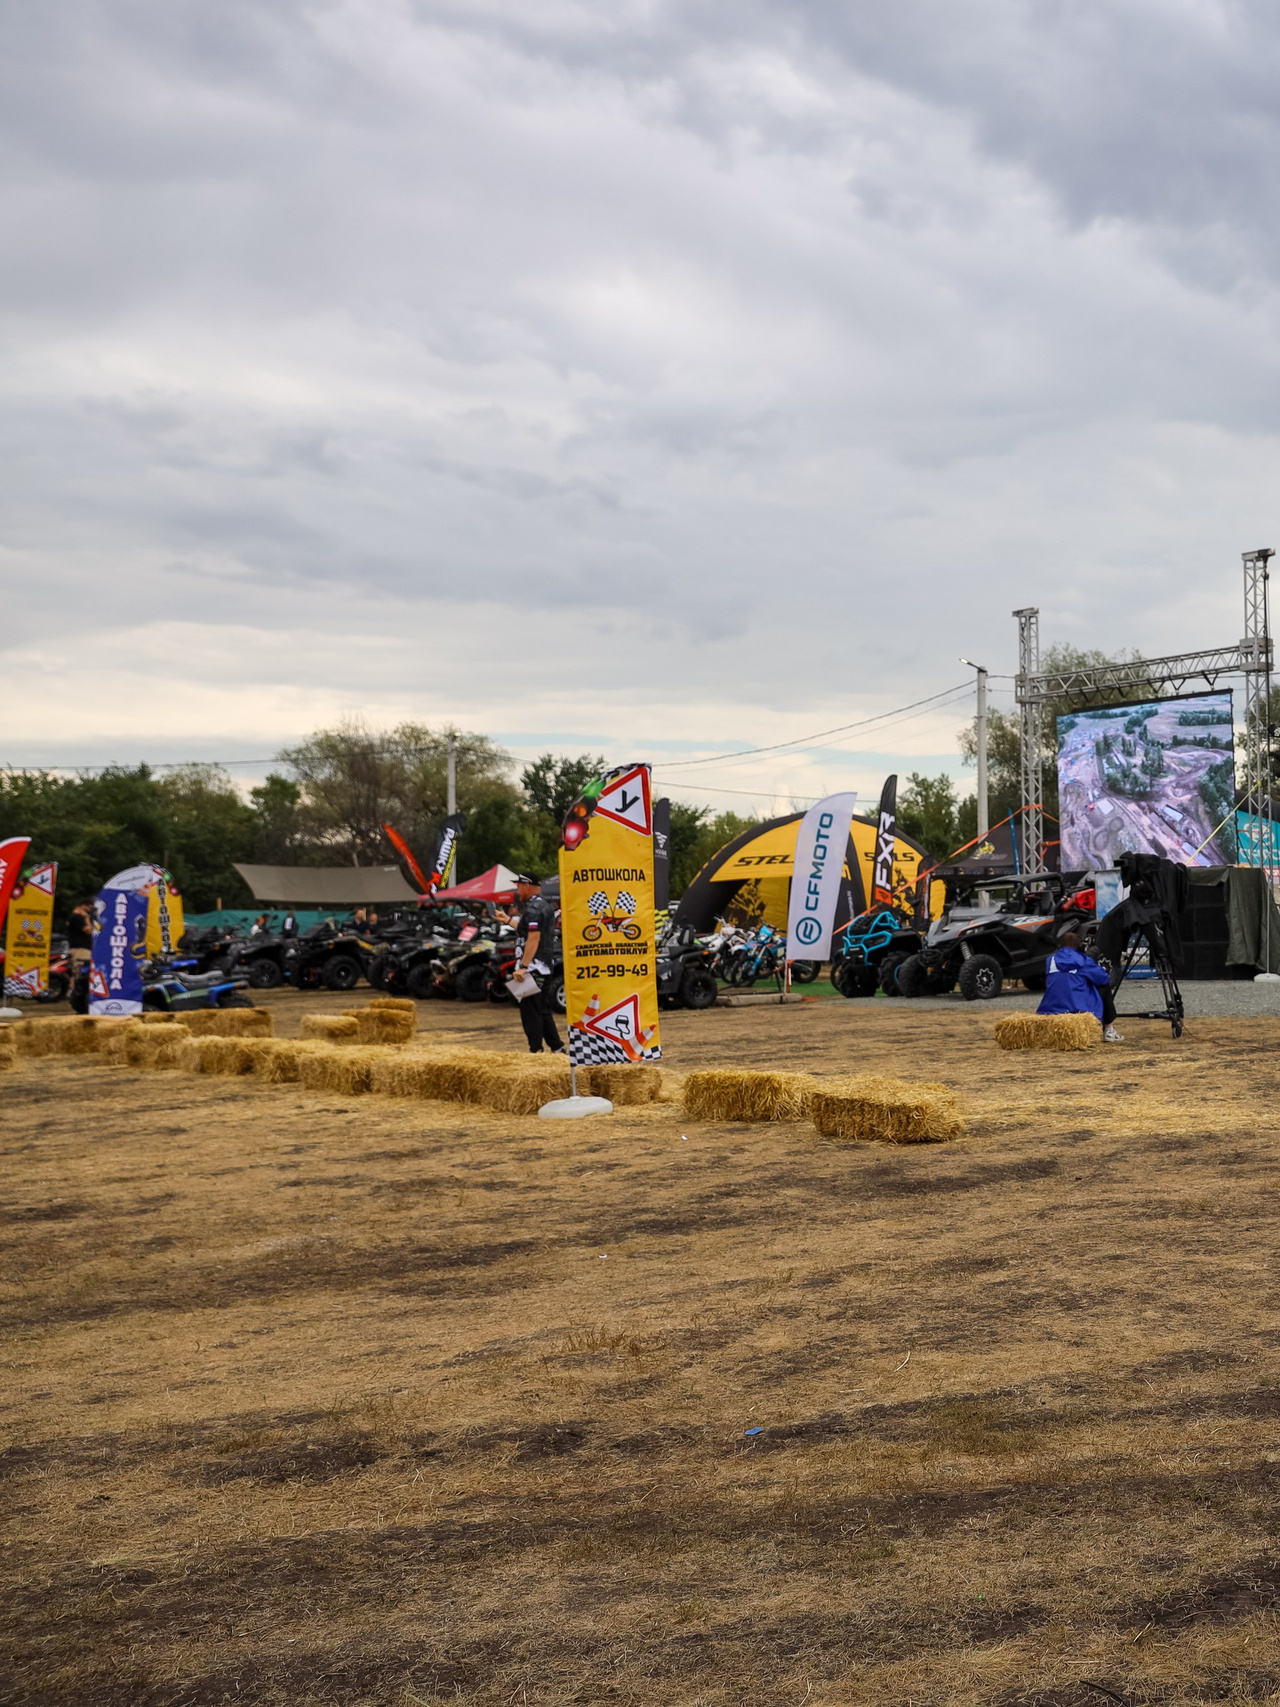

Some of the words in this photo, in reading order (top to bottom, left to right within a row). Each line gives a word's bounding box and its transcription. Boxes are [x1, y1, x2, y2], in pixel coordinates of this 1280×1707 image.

[615, 789, 640, 813] У
[734, 854, 795, 867] STEL
[875, 811, 896, 891] FXR
[805, 812, 834, 911] CFMOTO
[573, 868, 646, 883] АВТОШКОЛА
[109, 893, 128, 990] АВТОШКОЛА
[576, 948, 647, 957] АВТОМОТОКЛУБ
[576, 964, 648, 979] 212-99-49
